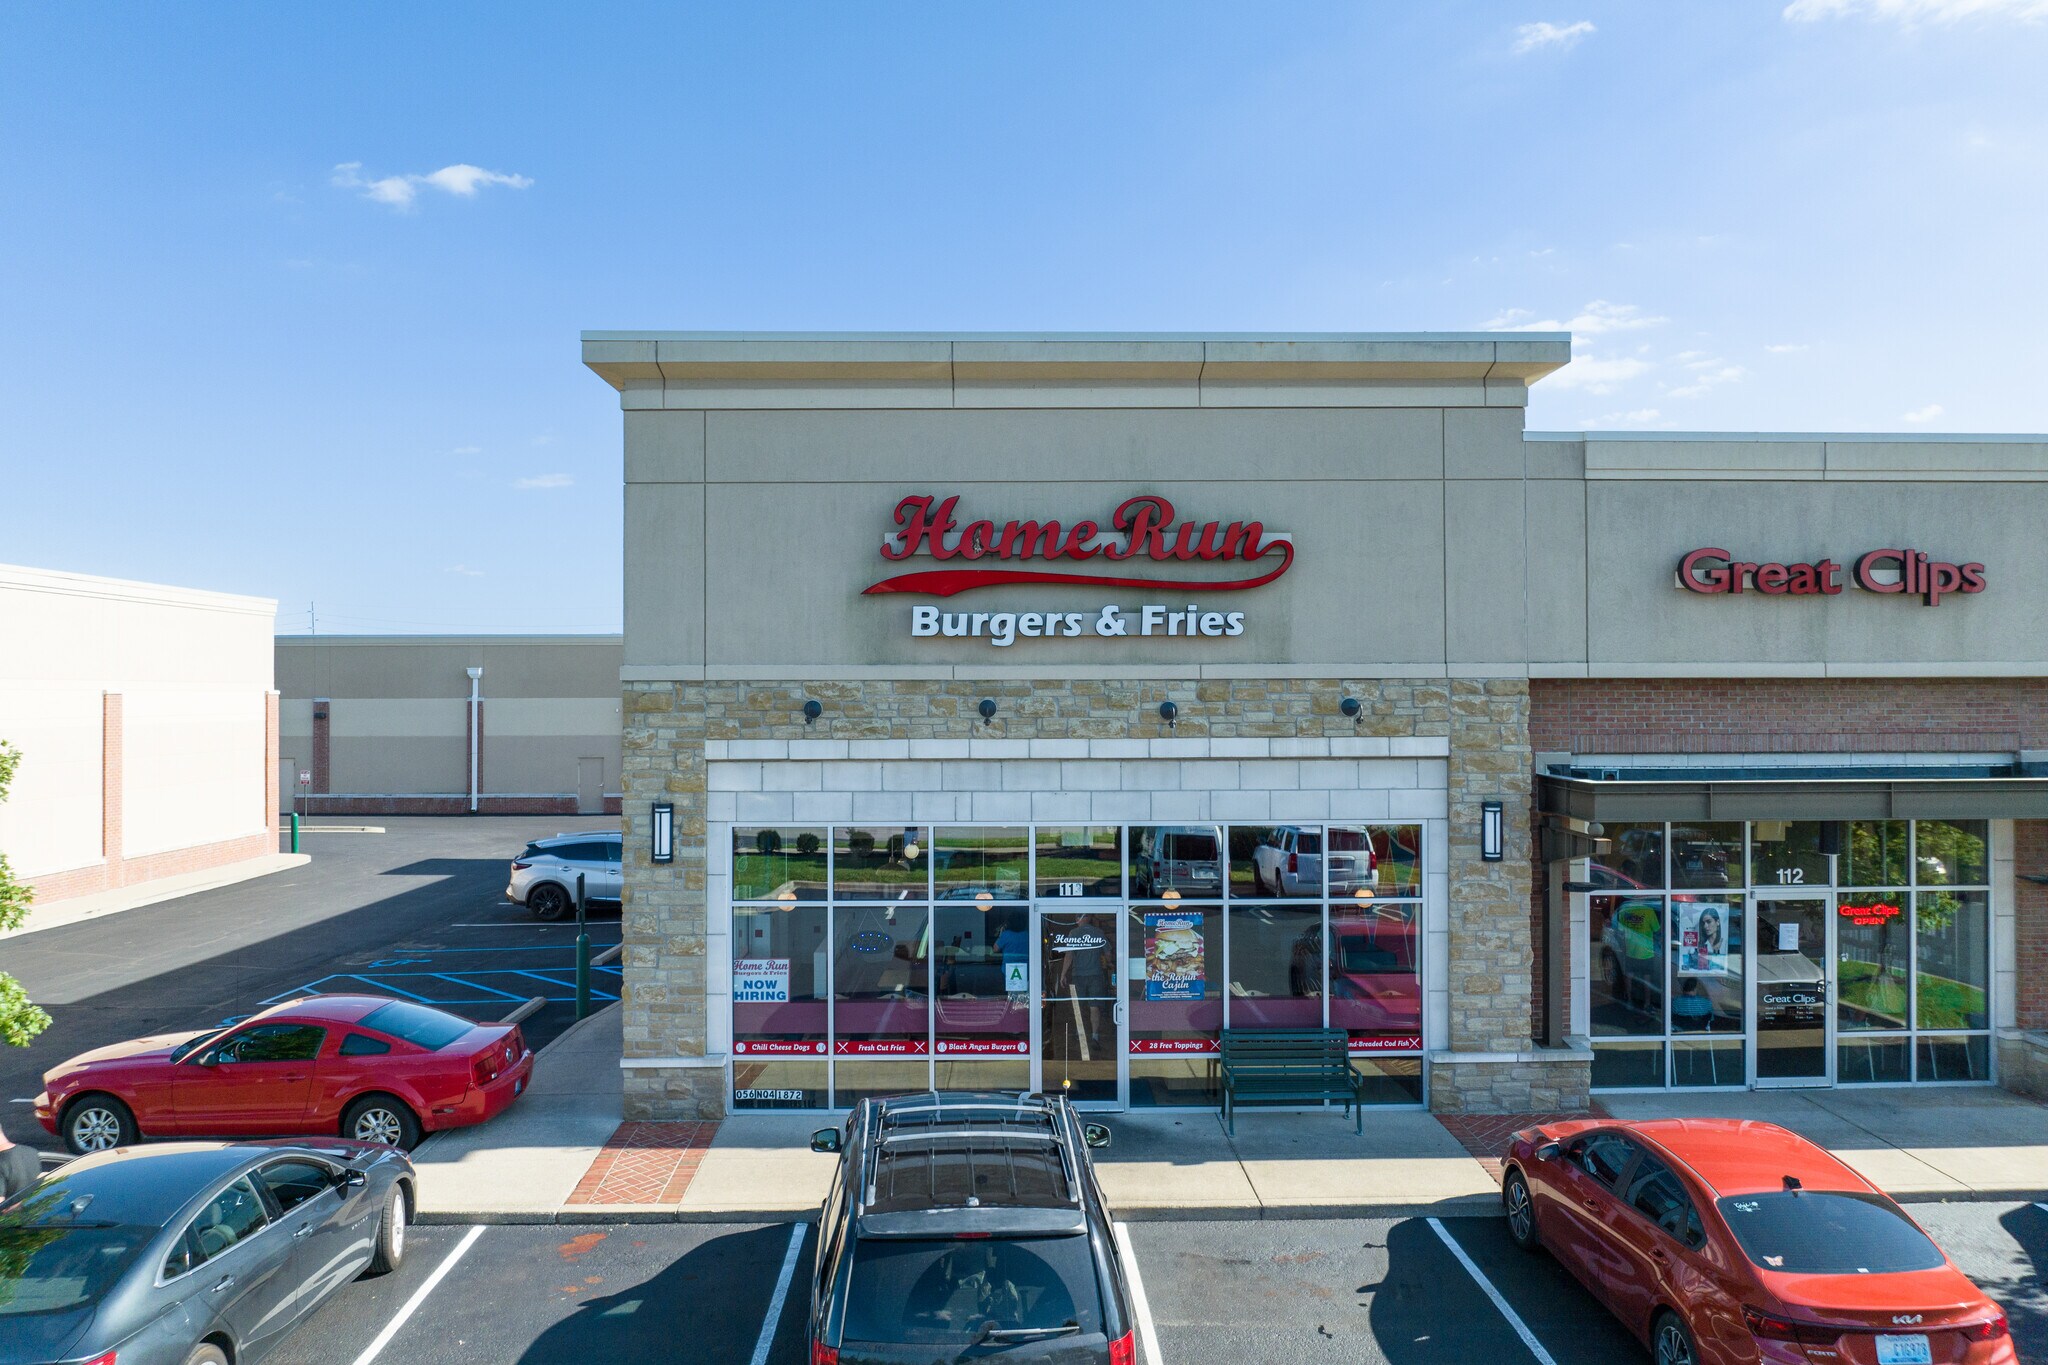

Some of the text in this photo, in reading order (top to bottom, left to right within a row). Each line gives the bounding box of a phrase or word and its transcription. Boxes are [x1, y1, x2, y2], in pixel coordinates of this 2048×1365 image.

[880, 495, 1282, 561] Home Run
[1677, 547, 1987, 607] Great Clips
[911, 604, 1246, 647] Burgers & Fries
[1776, 868, 1804, 884] 112
[1839, 903, 1899, 918] Great Clips
[1853, 917, 1885, 926] OPEN
[1054, 934, 1103, 944] Home Run
[733, 960, 788, 970] Home Run
[1010, 966, 1022, 980] A
[743, 980, 777, 989] NOW
[734, 991, 786, 1001] HIRING
[1763, 994, 1816, 1005] Great Clips
[751, 1043, 810, 1052] Chili Cheese Dogs
[968, 1043, 990, 1051] Angus
[991, 1043, 1016, 1051] Burgers
[1174, 1042, 1203, 1050] Toppings
[1348, 1040, 1383, 1048] nd-Breaded
[778, 1091, 802, 1100] 1872
